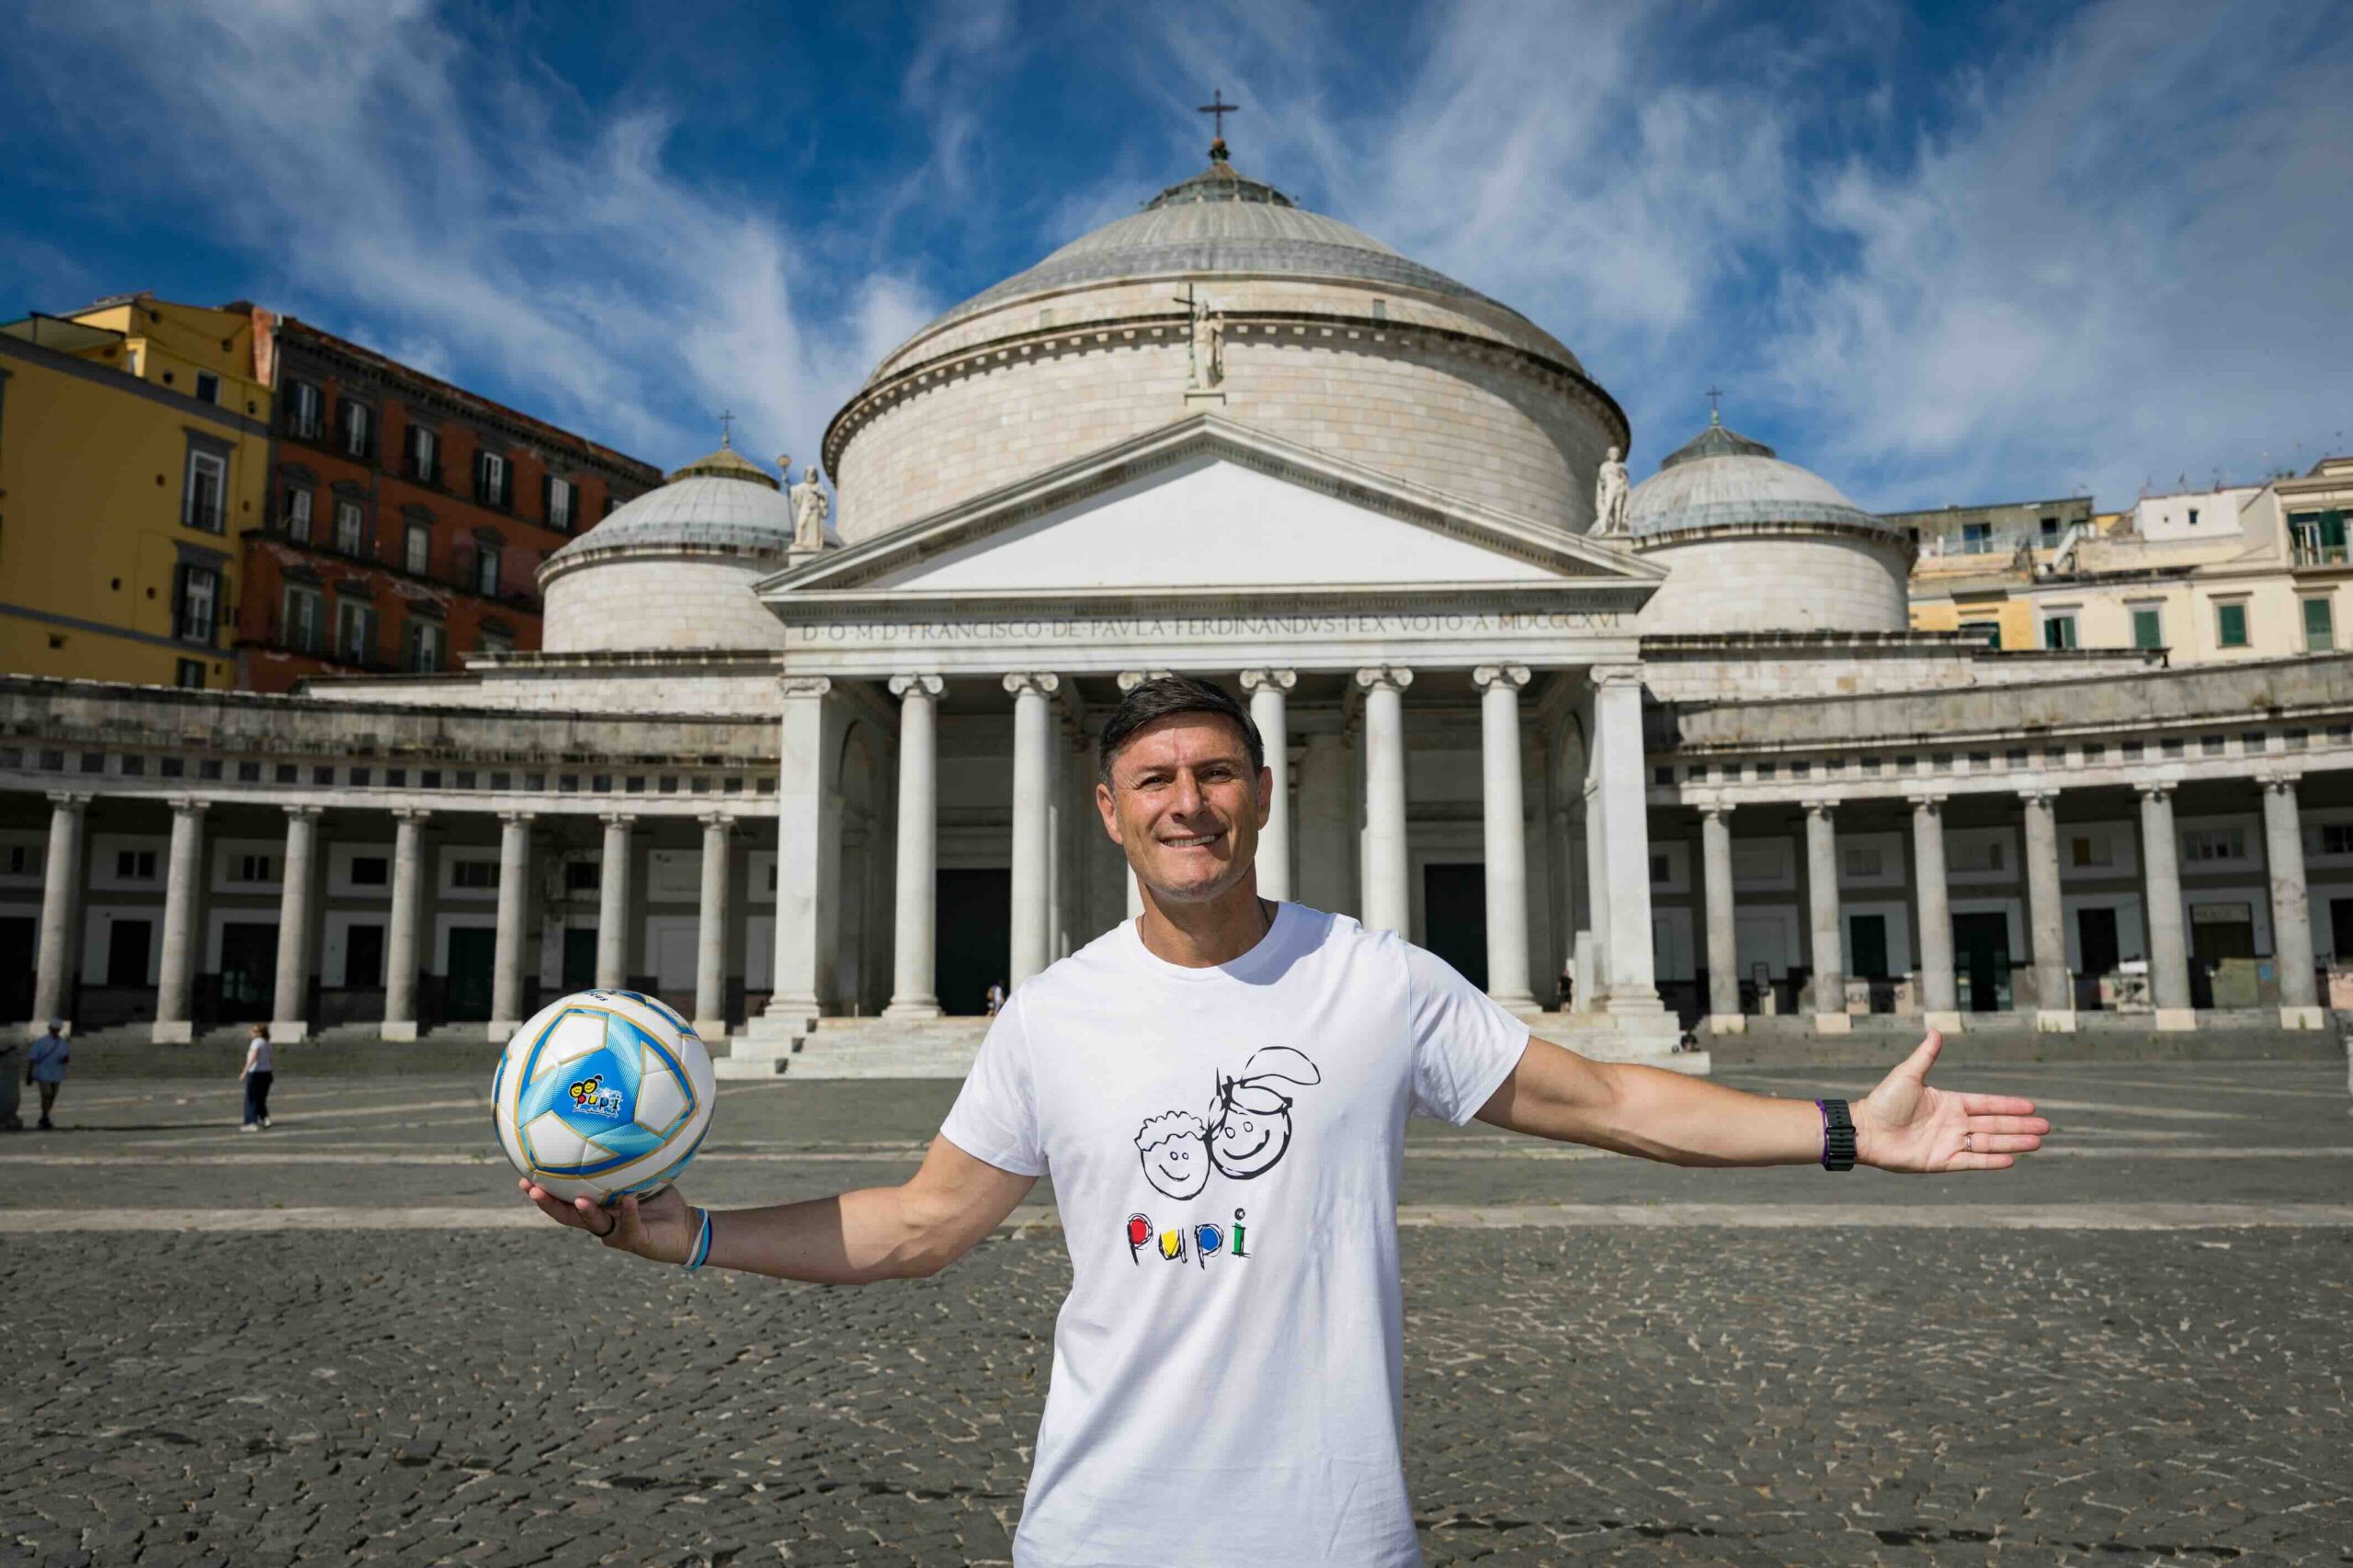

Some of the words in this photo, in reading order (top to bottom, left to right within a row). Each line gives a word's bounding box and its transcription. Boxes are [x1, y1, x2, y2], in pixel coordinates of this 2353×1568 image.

[828, 622, 846, 641] O
[856, 622, 874, 641] M
[881, 621, 898, 640] D
[907, 620, 1041, 641] FRANCISCO
[1052, 619, 1080, 638] DE
[1091, 619, 1165, 637] PAVLA
[1175, 617, 1336, 636] FERDINANDVS
[1358, 616, 1387, 633] EX
[1397, 614, 1463, 631] VOTO
[1473, 613, 1489, 630] A
